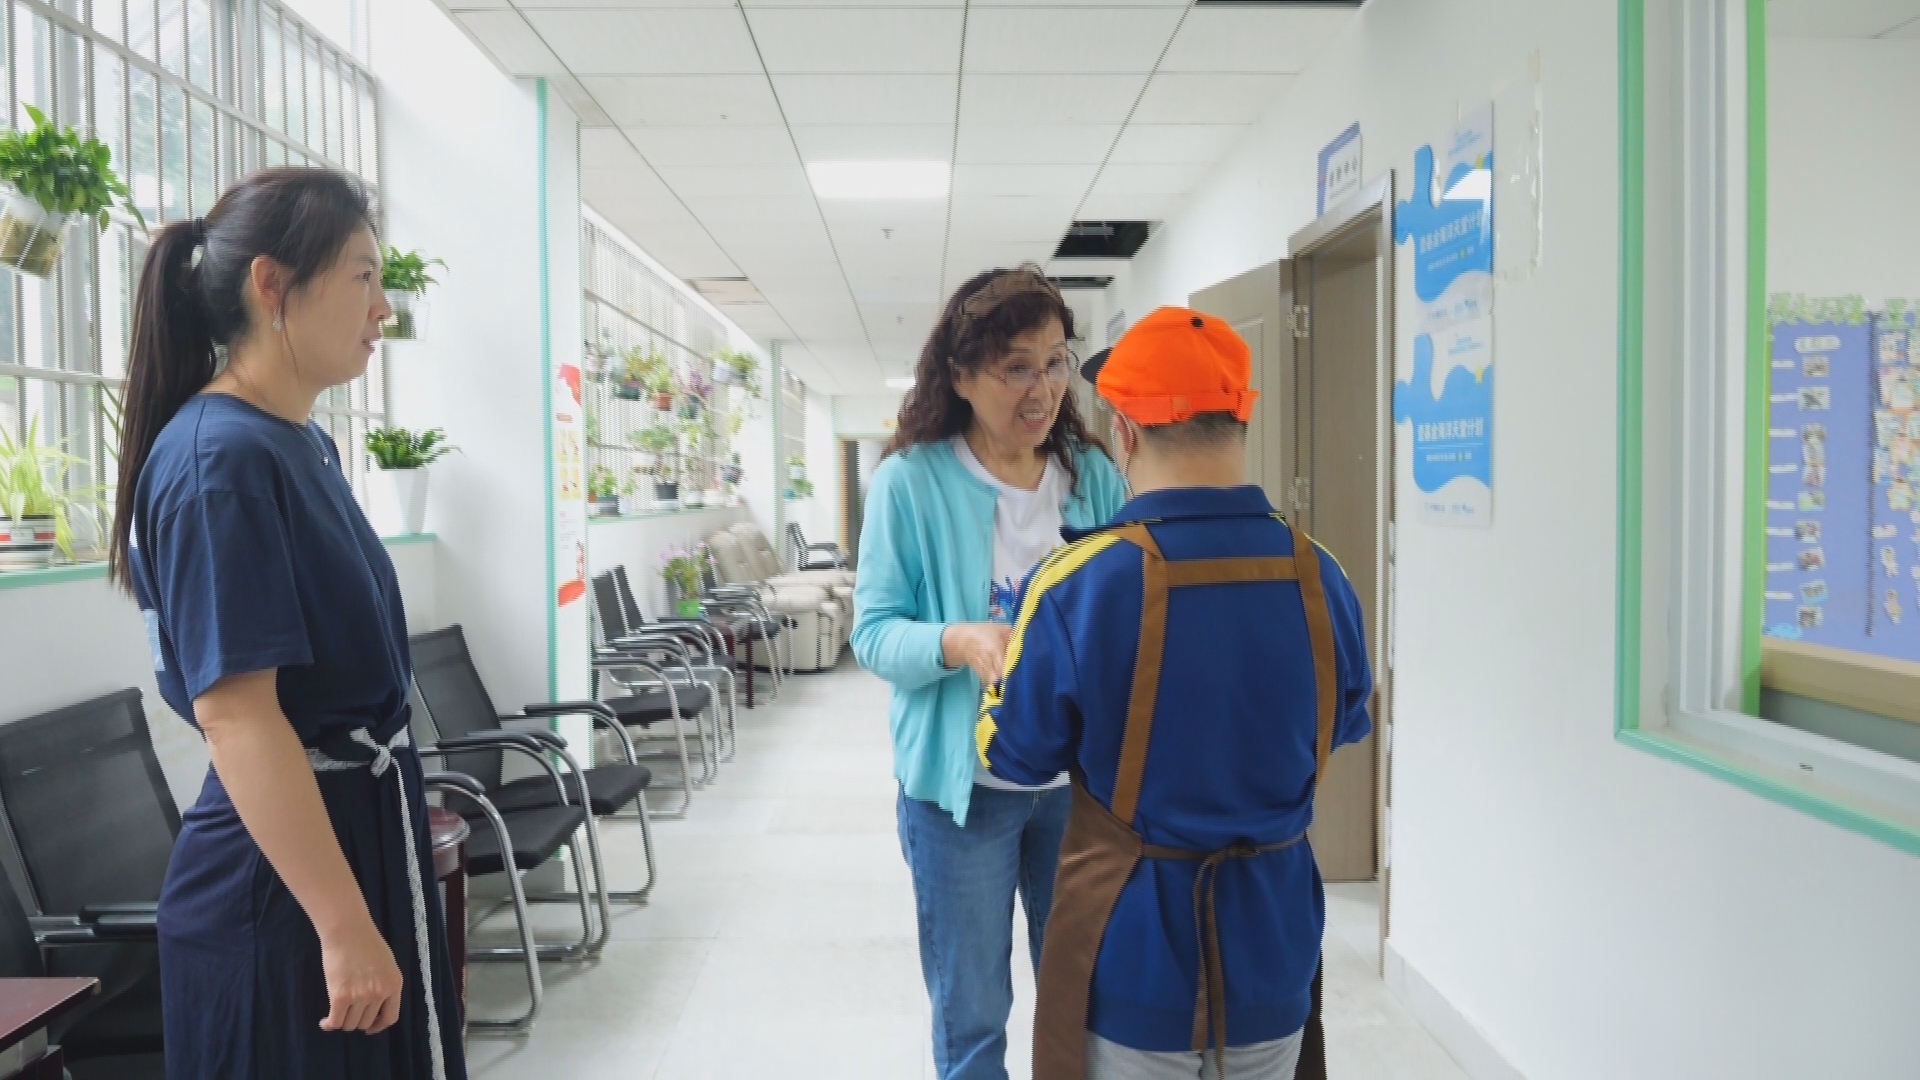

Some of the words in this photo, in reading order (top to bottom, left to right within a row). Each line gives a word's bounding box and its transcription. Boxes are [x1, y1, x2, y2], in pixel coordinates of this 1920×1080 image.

[1417, 418, 1484, 442] 壹基金海洋天堂计划
